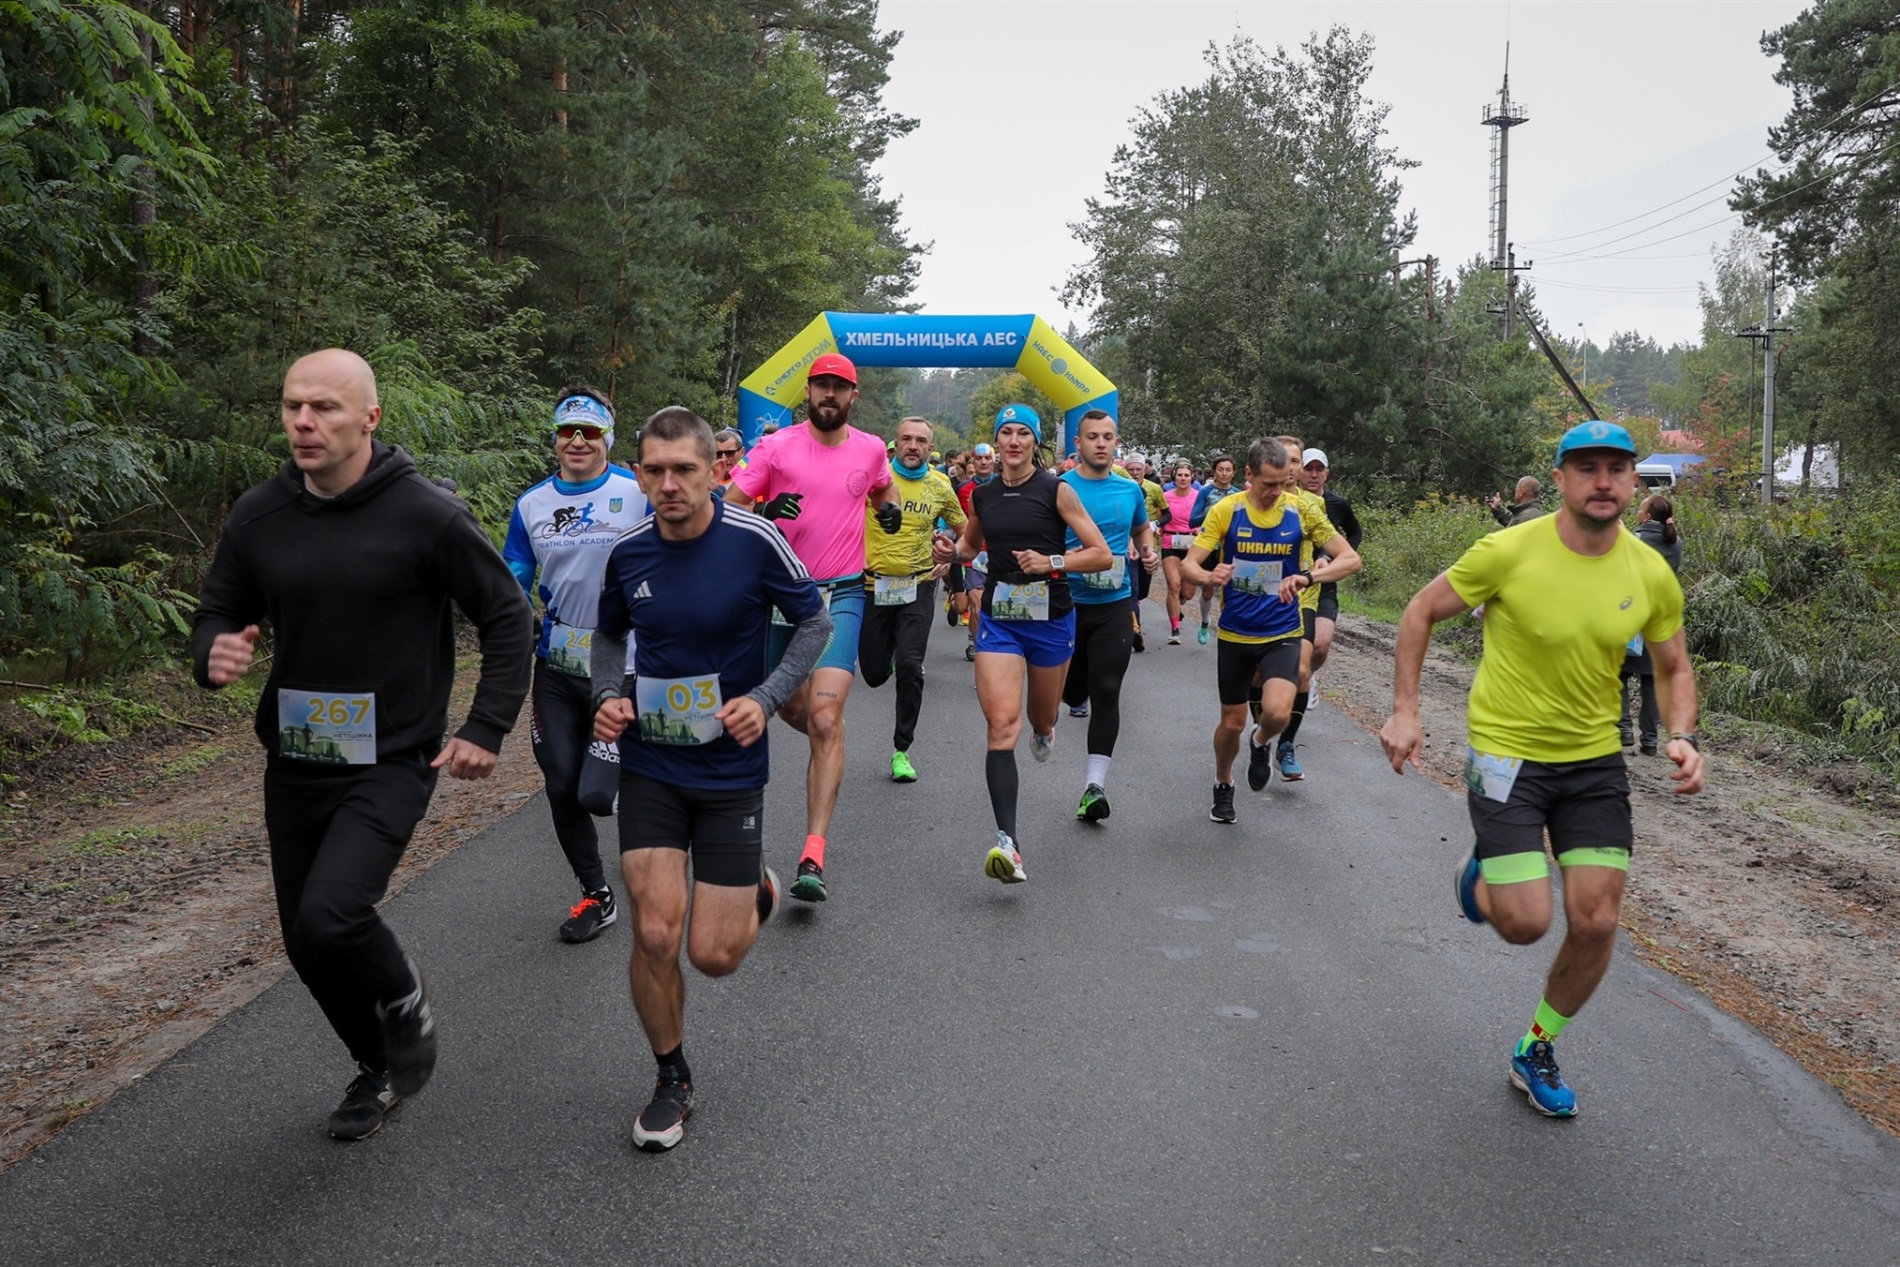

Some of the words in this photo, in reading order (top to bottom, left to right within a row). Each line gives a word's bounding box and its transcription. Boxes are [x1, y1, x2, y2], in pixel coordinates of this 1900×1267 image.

[845, 331, 978, 349] ХМЕЛЬНИЦЬКА
[982, 332, 1017, 346] АЕС
[903, 500, 932, 515] RUN
[1237, 541, 1293, 555] UKRAINE
[1256, 563, 1281, 577] 211
[1009, 582, 1047, 598] 203
[667, 680, 717, 713] 03
[307, 697, 371, 725] 267
